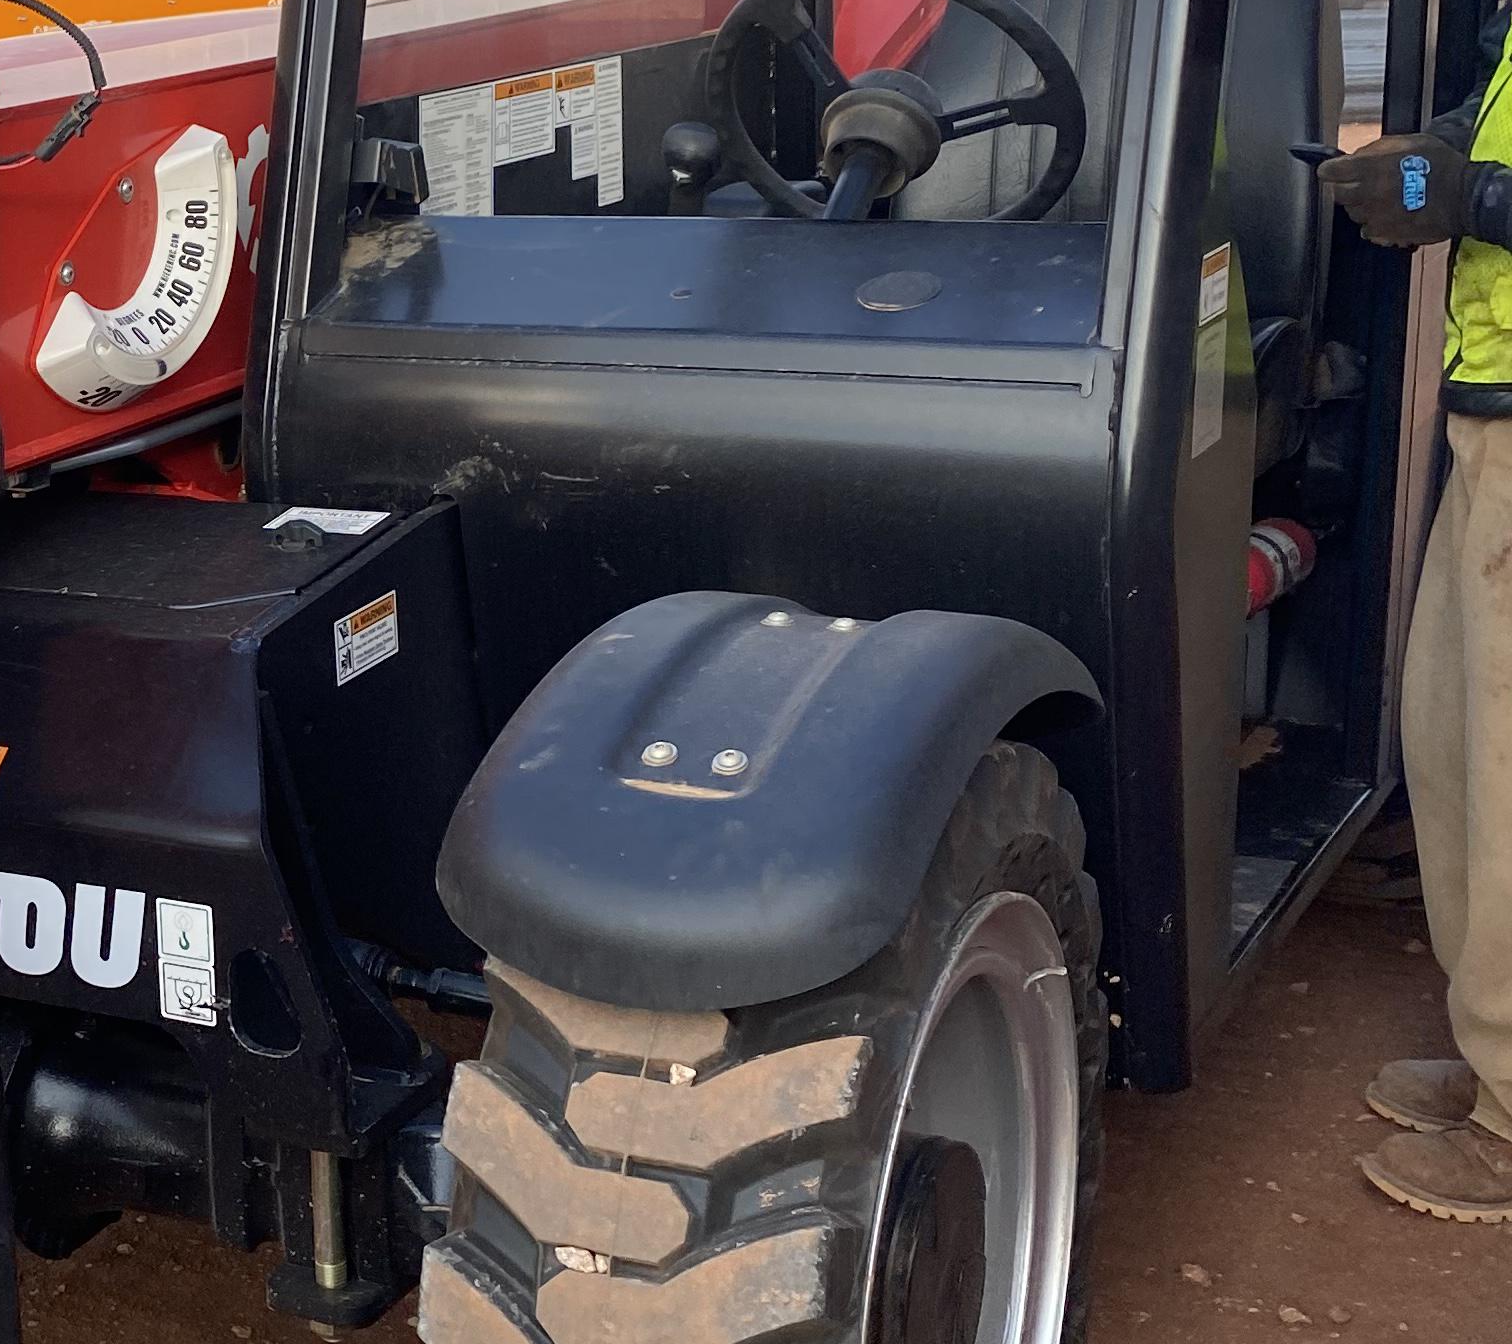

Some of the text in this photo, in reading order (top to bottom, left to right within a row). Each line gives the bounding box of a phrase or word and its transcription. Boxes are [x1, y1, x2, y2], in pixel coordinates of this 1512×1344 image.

[184, 199, 209, 230] 80
[178, 240, 206, 273] 60
[166, 278, 194, 308] 40
[131, 326, 151, 346] 0
[148, 307, 177, 336] 20
